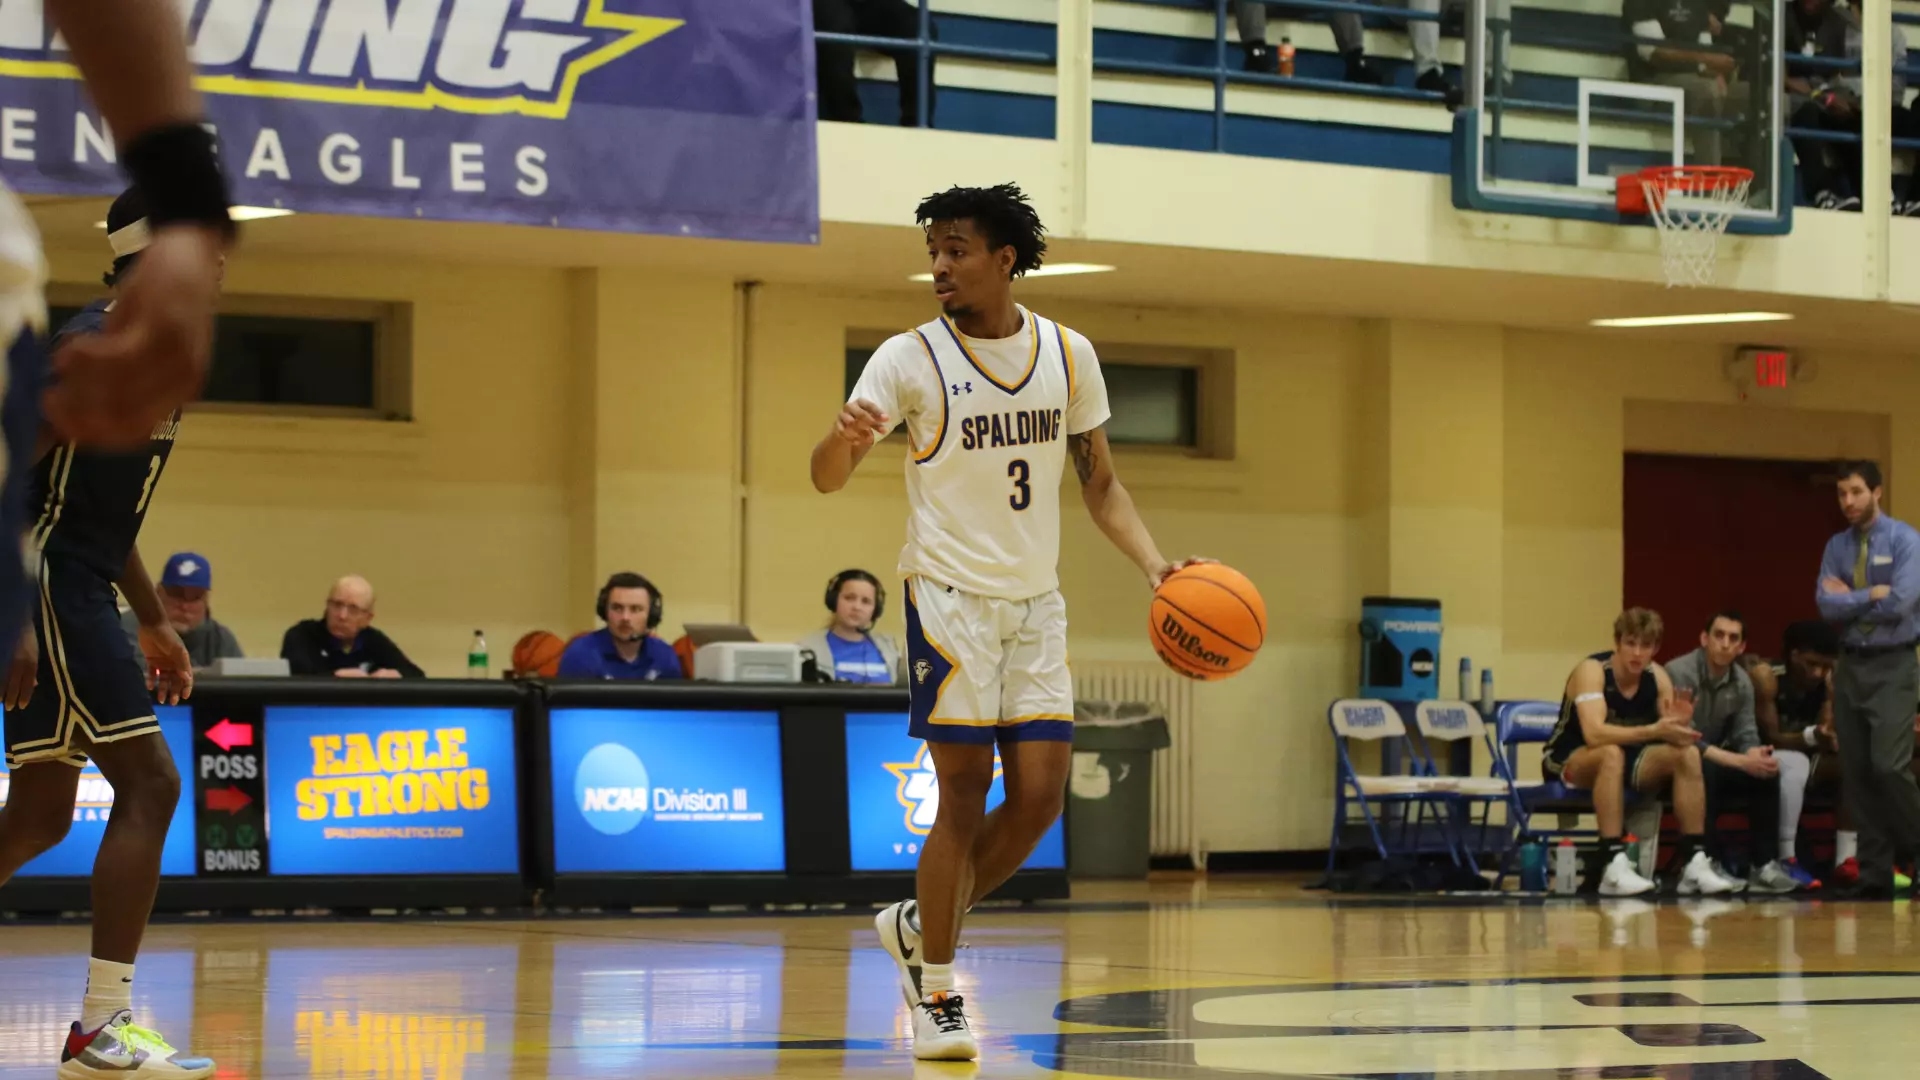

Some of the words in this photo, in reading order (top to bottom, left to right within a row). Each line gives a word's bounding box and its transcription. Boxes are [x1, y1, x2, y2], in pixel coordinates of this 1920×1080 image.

[198, 122, 550, 197] AGLES
[1756, 352, 1787, 389] EXIT
[961, 408, 1062, 451] SPALDING
[1007, 459, 1031, 511] 3
[1161, 613, 1230, 667] Wilson
[200, 755, 258, 779] POSS
[309, 727, 469, 776] EAGLE
[296, 768, 490, 821] STRONG
[584, 787, 648, 812] NCAA
[653, 787, 728, 812] Division
[733, 788, 748, 811] III
[204, 849, 261, 871] BONUS
